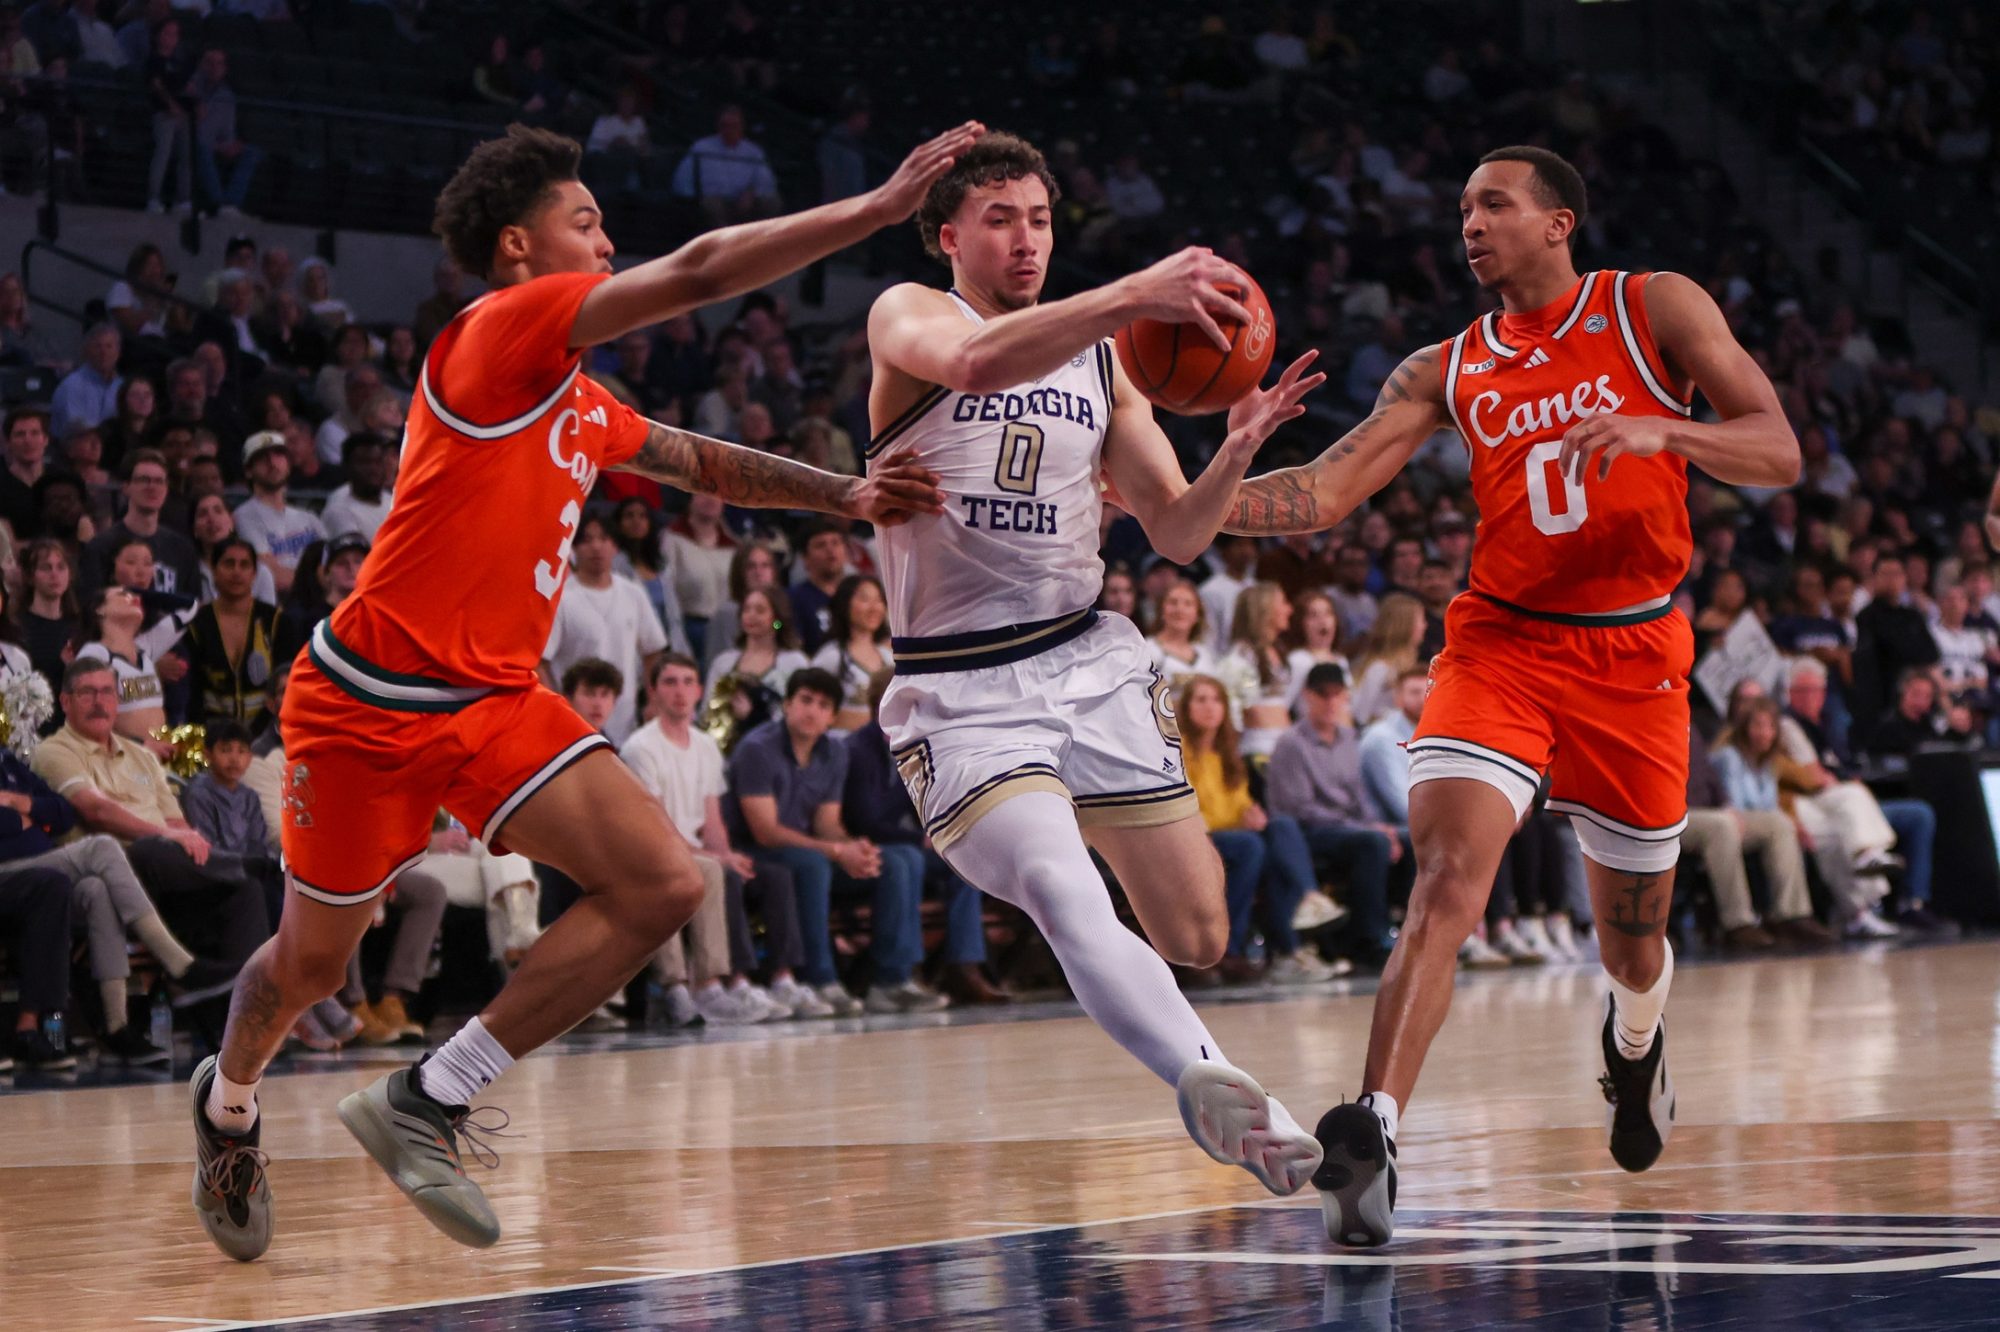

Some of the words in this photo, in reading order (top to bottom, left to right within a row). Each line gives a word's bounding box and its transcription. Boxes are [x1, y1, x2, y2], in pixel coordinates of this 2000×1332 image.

[953, 387, 1094, 431] GEORGIA
[1469, 374, 1625, 448] Canes
[995, 421, 1045, 497] 0
[1525, 440, 1588, 536] 0
[534, 500, 580, 601] 3
[961, 496, 1058, 535] TECH
